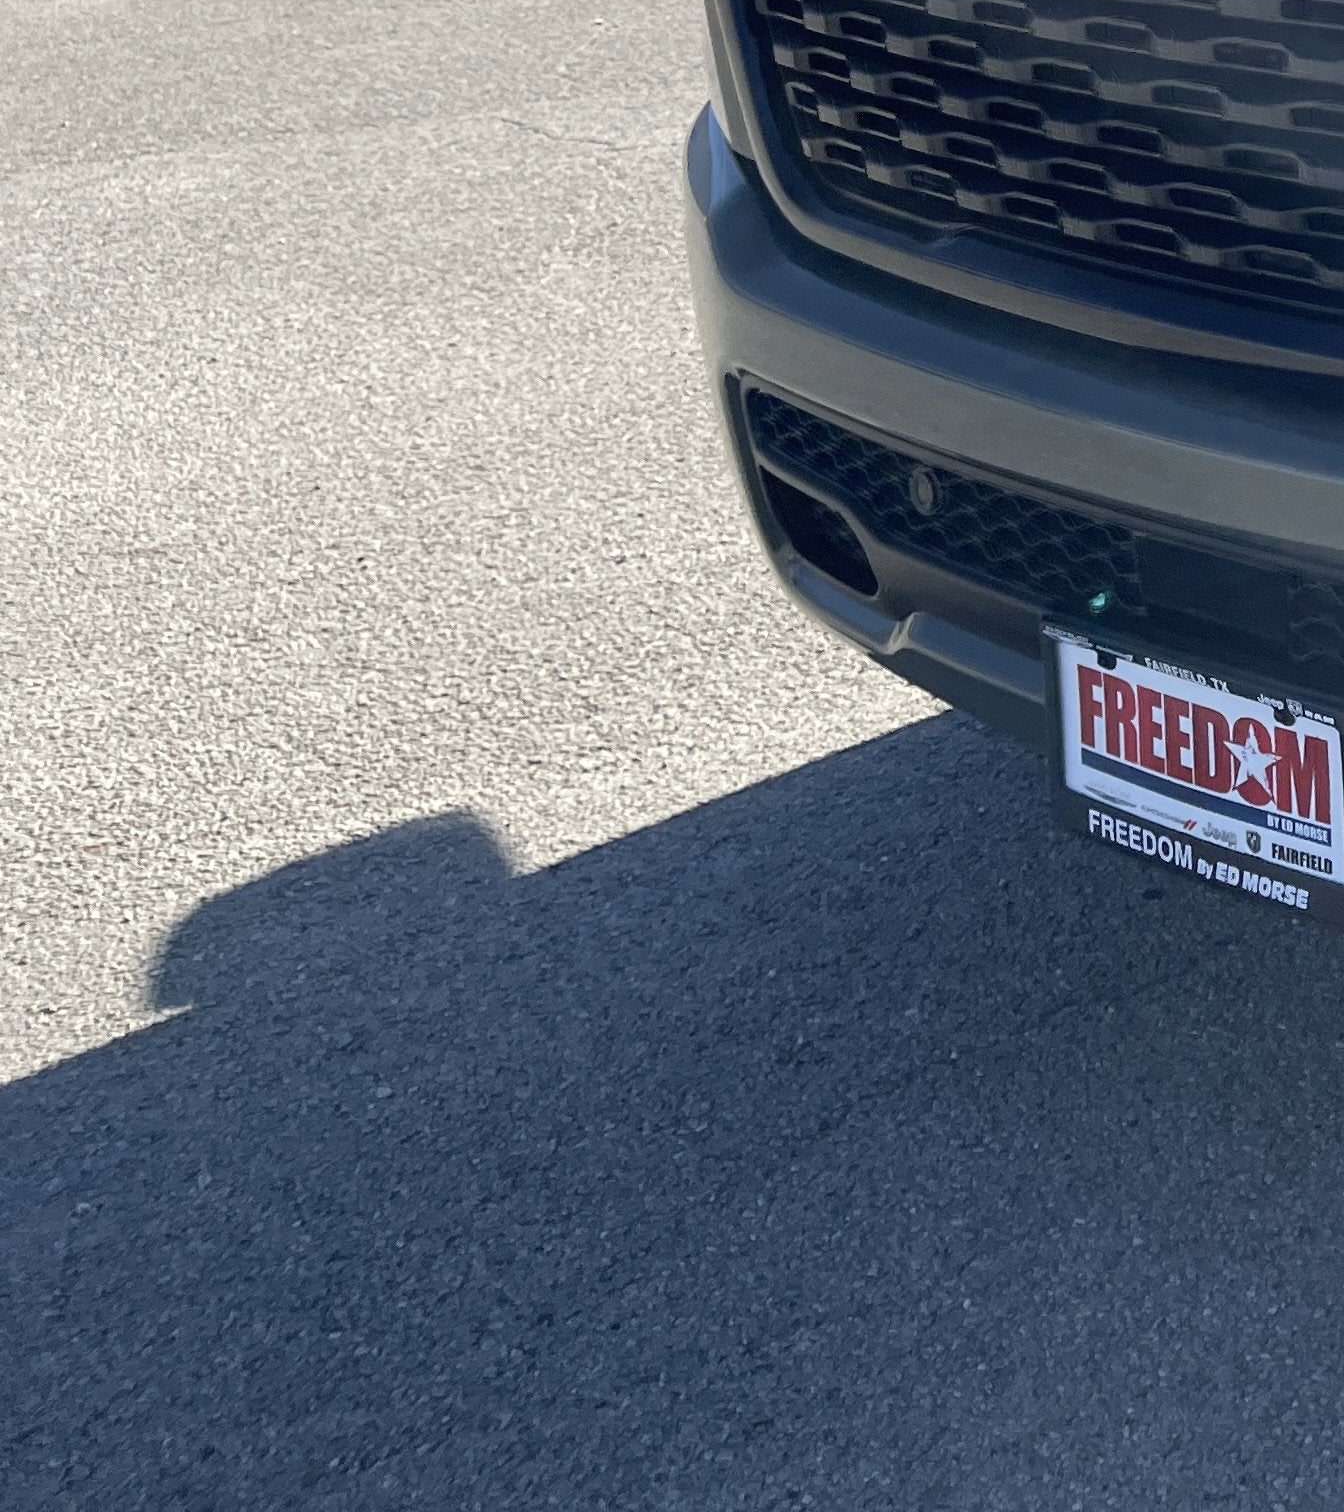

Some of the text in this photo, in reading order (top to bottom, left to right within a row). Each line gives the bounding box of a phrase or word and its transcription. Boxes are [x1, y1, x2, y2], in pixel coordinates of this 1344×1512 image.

[1210, 677, 1230, 693] TX
[1077, 663, 1332, 825] FREEDOM
[1267, 813, 1329, 844] BY ED MORSE
[1088, 808, 1193, 870] FREEDOM
[1215, 861, 1240, 887] ED
[1241, 870, 1310, 911] MORSE
[1271, 842, 1334, 876] FAIRFIELD
